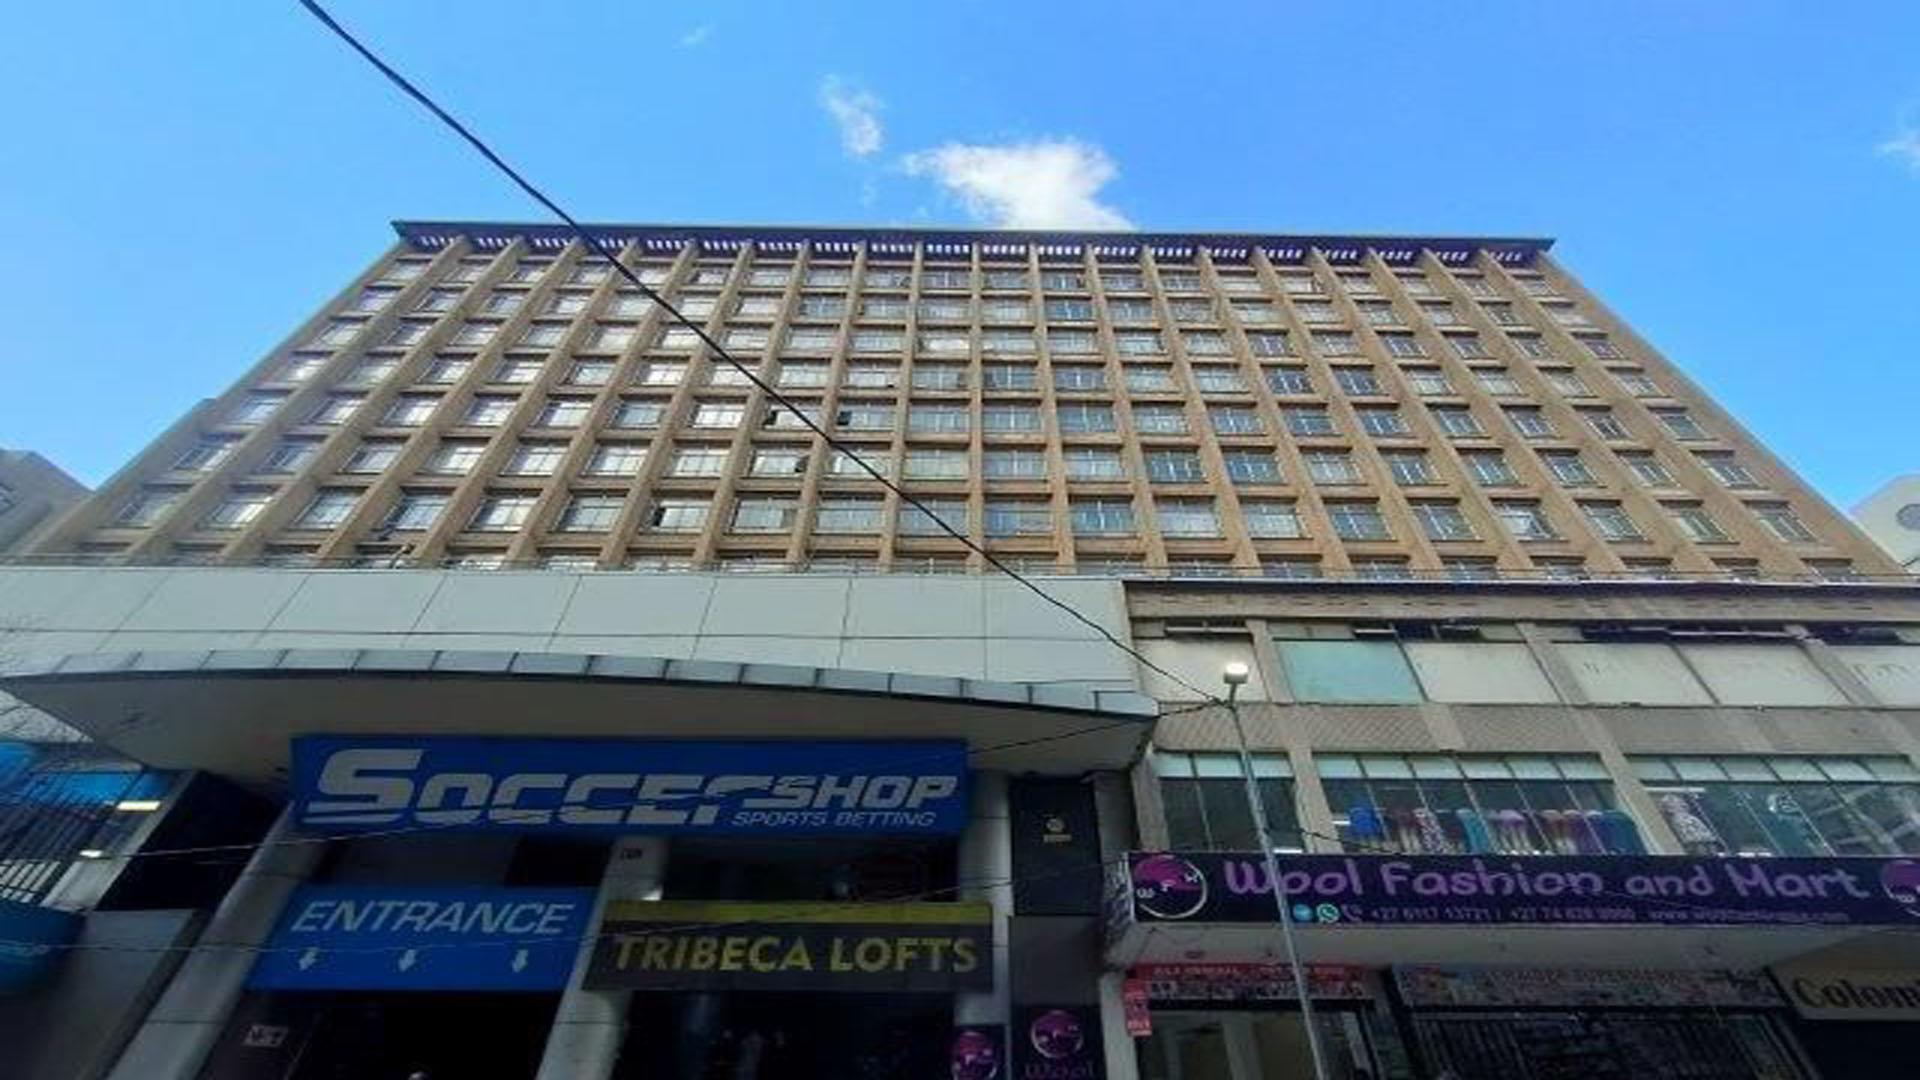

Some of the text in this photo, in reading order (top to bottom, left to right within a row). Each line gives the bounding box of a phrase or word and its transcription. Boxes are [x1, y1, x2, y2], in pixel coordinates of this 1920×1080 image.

[742, 775, 958, 809] SHOP
[732, 811, 938, 829] SPORTS BETTING
[1224, 858, 1871, 897] Wool Fashion and Mart
[289, 899, 576, 935] ENTRANCE
[614, 934, 979, 973] TRIBECA LOFTS
[1793, 975, 1920, 1008] Colom
